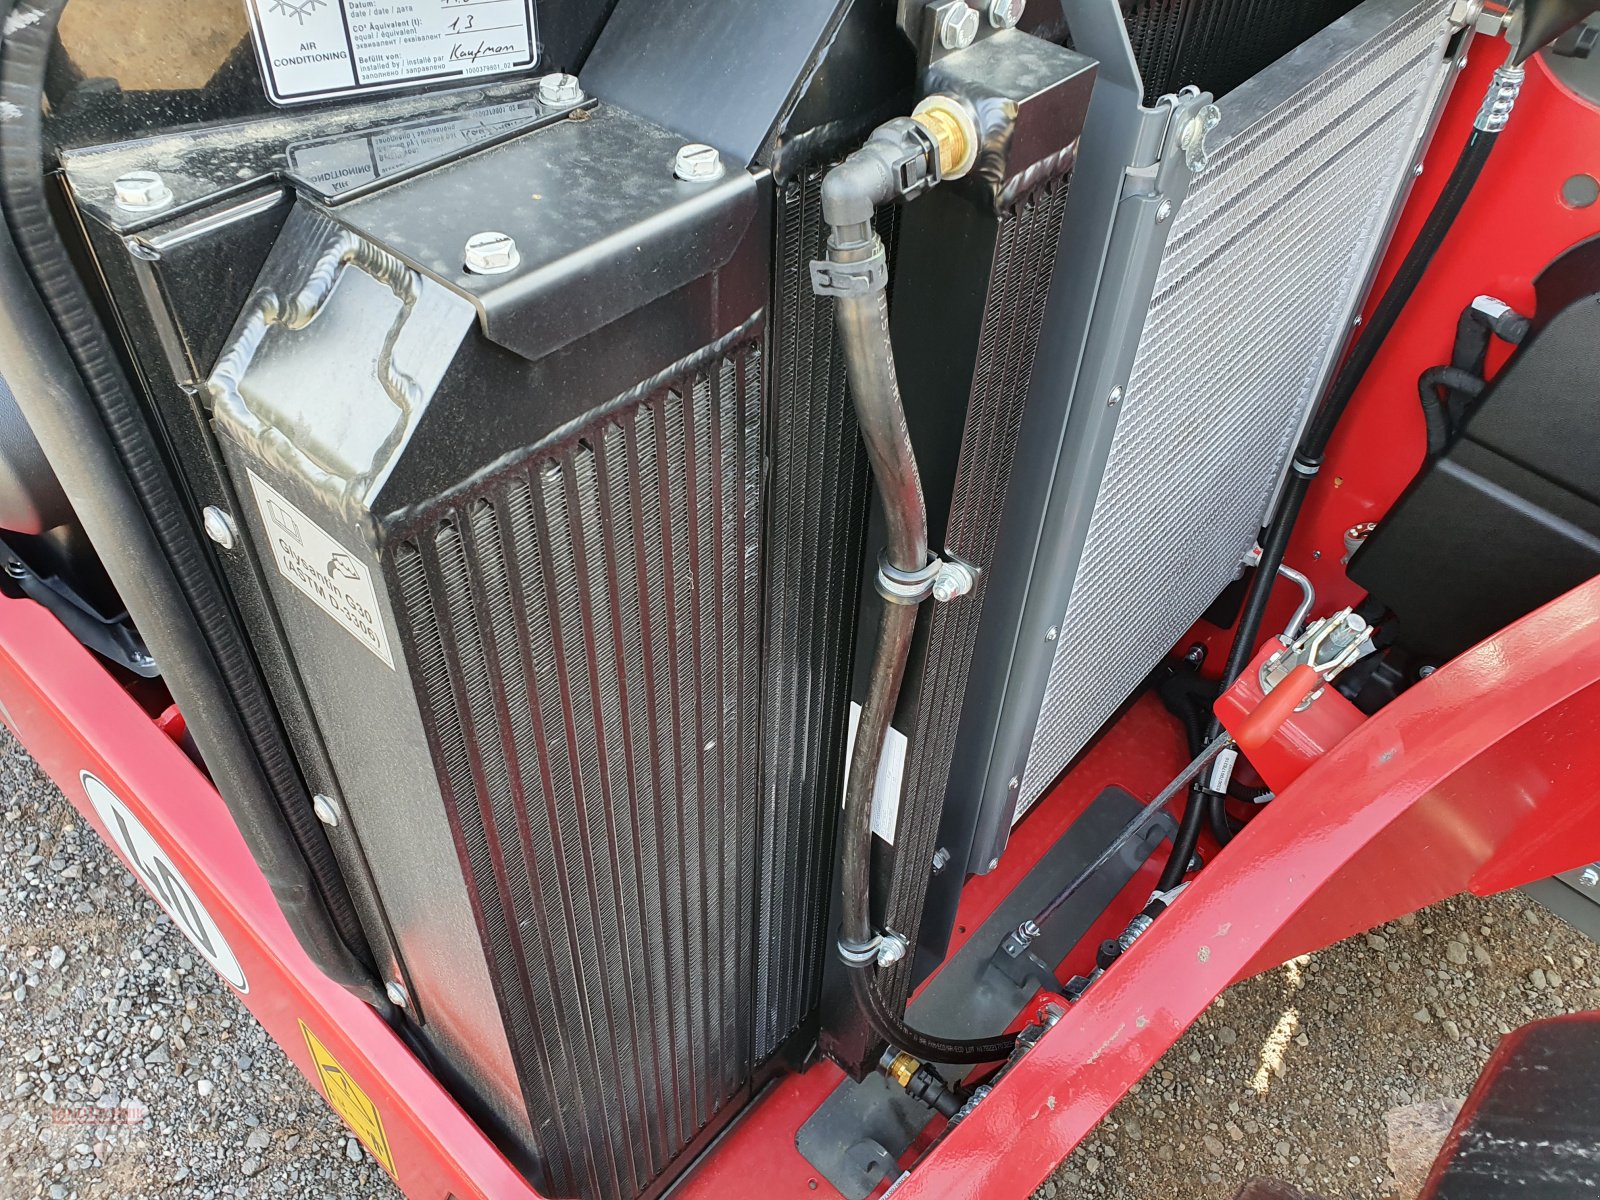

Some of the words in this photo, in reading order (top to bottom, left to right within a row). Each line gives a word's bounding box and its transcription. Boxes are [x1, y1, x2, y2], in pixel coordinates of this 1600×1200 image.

[349, 1, 376, 9] Datum:
[351, 10, 366, 18] date
[374, 7, 389, 15] date
[396, 5, 413, 14] дата
[370, 20, 409, 31] Äquivalent
[354, 32, 374, 41] equal
[381, 27, 417, 39] équivalent
[300, 41, 317, 51] AIR
[273, 51, 347, 67] CONDITIONING
[358, 54, 383, 64] Befüllt
[360, 62, 389, 71] installed
[392, 60, 400, 69] by
[433, 55, 444, 63] par
[279, 538, 342, 599] Glysantin
[345, 593, 373, 625] G30
[283, 555, 326, 601] (ASTM
[331, 597, 381, 649] D-3306)
